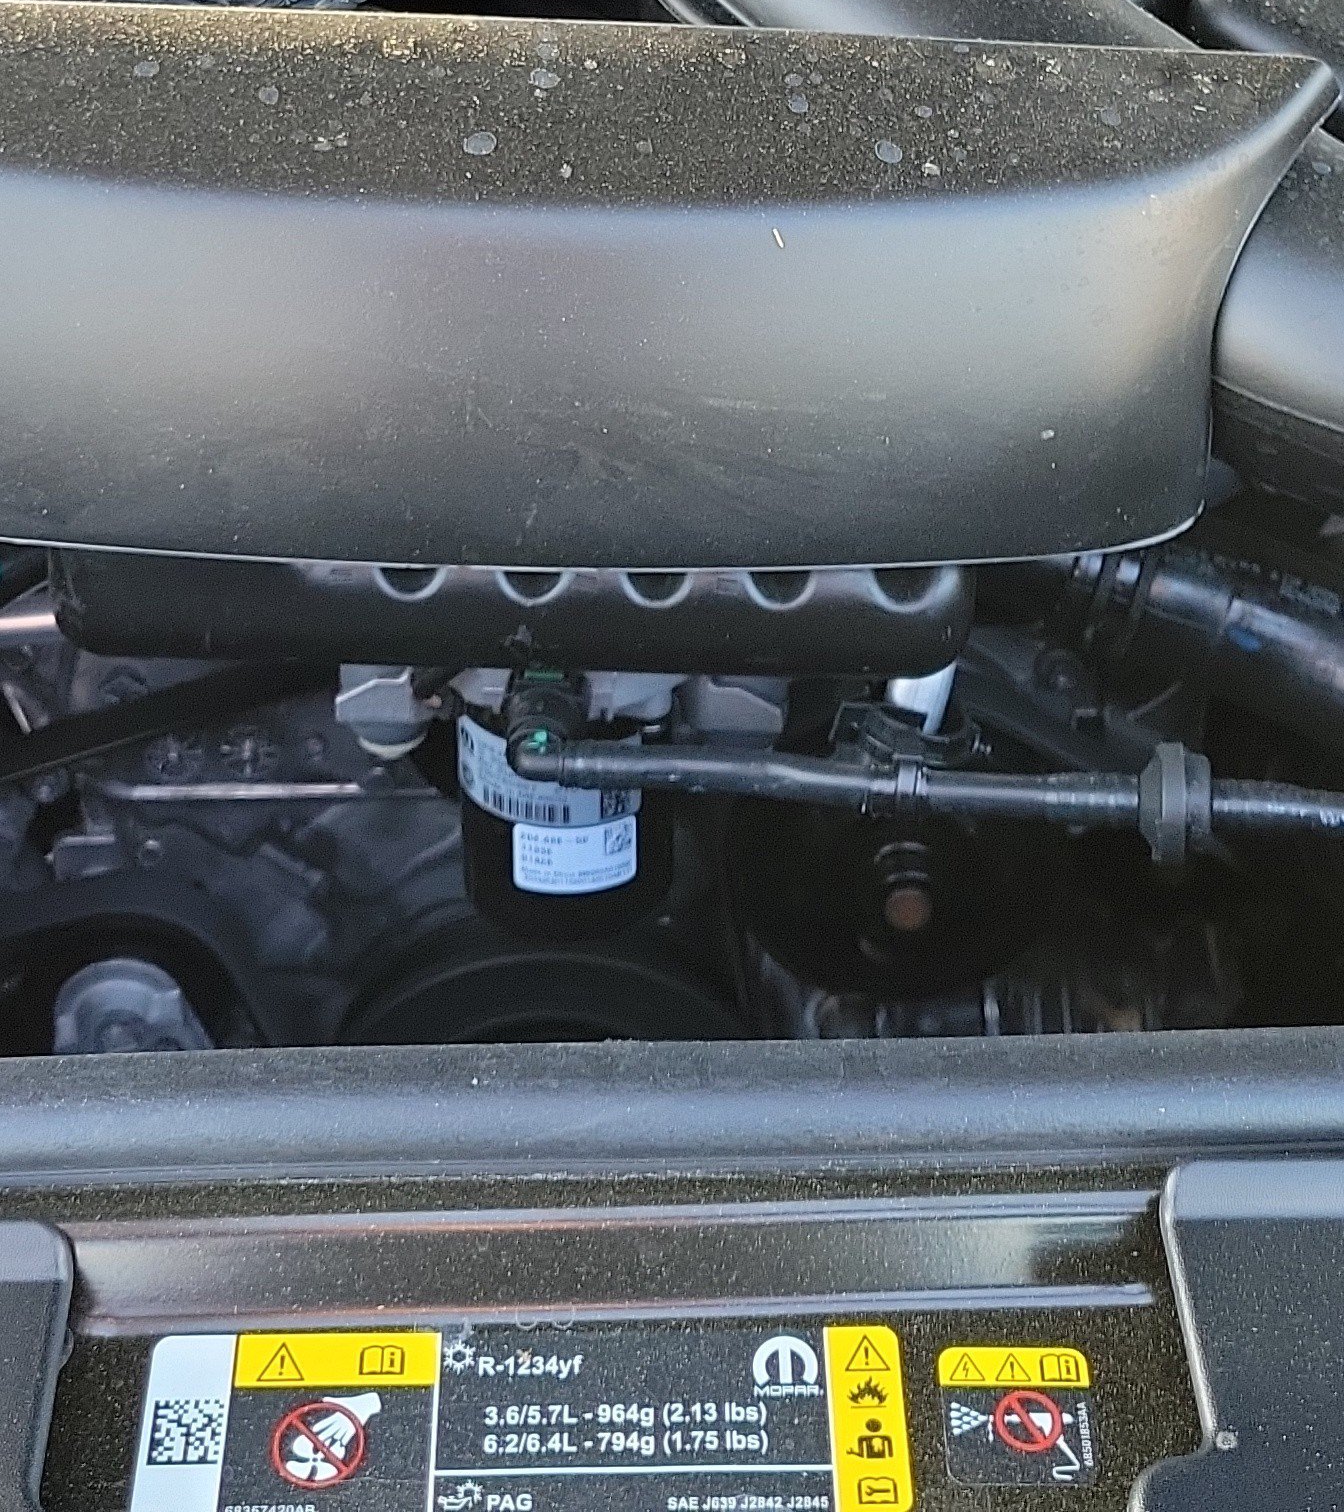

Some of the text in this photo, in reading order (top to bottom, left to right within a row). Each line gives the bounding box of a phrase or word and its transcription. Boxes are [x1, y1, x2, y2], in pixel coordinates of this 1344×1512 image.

[477, 1354, 583, 1380] R-1234yf
[484, 1405, 578, 1426] 3.6/5.7L
[597, 1403, 655, 1429] 964g
[662, 1402, 718, 1428] (2.13
[725, 1402, 768, 1428] lbs)
[483, 1433, 578, 1455] 6.2/6.4L
[597, 1431, 655, 1457] 794g
[662, 1430, 719, 1456] (1.75
[726, 1429, 770, 1456] lbs)
[485, 1494, 534, 1512] PAG
[666, 1496, 699, 1511] SAE
[702, 1496, 737, 1511] J639
